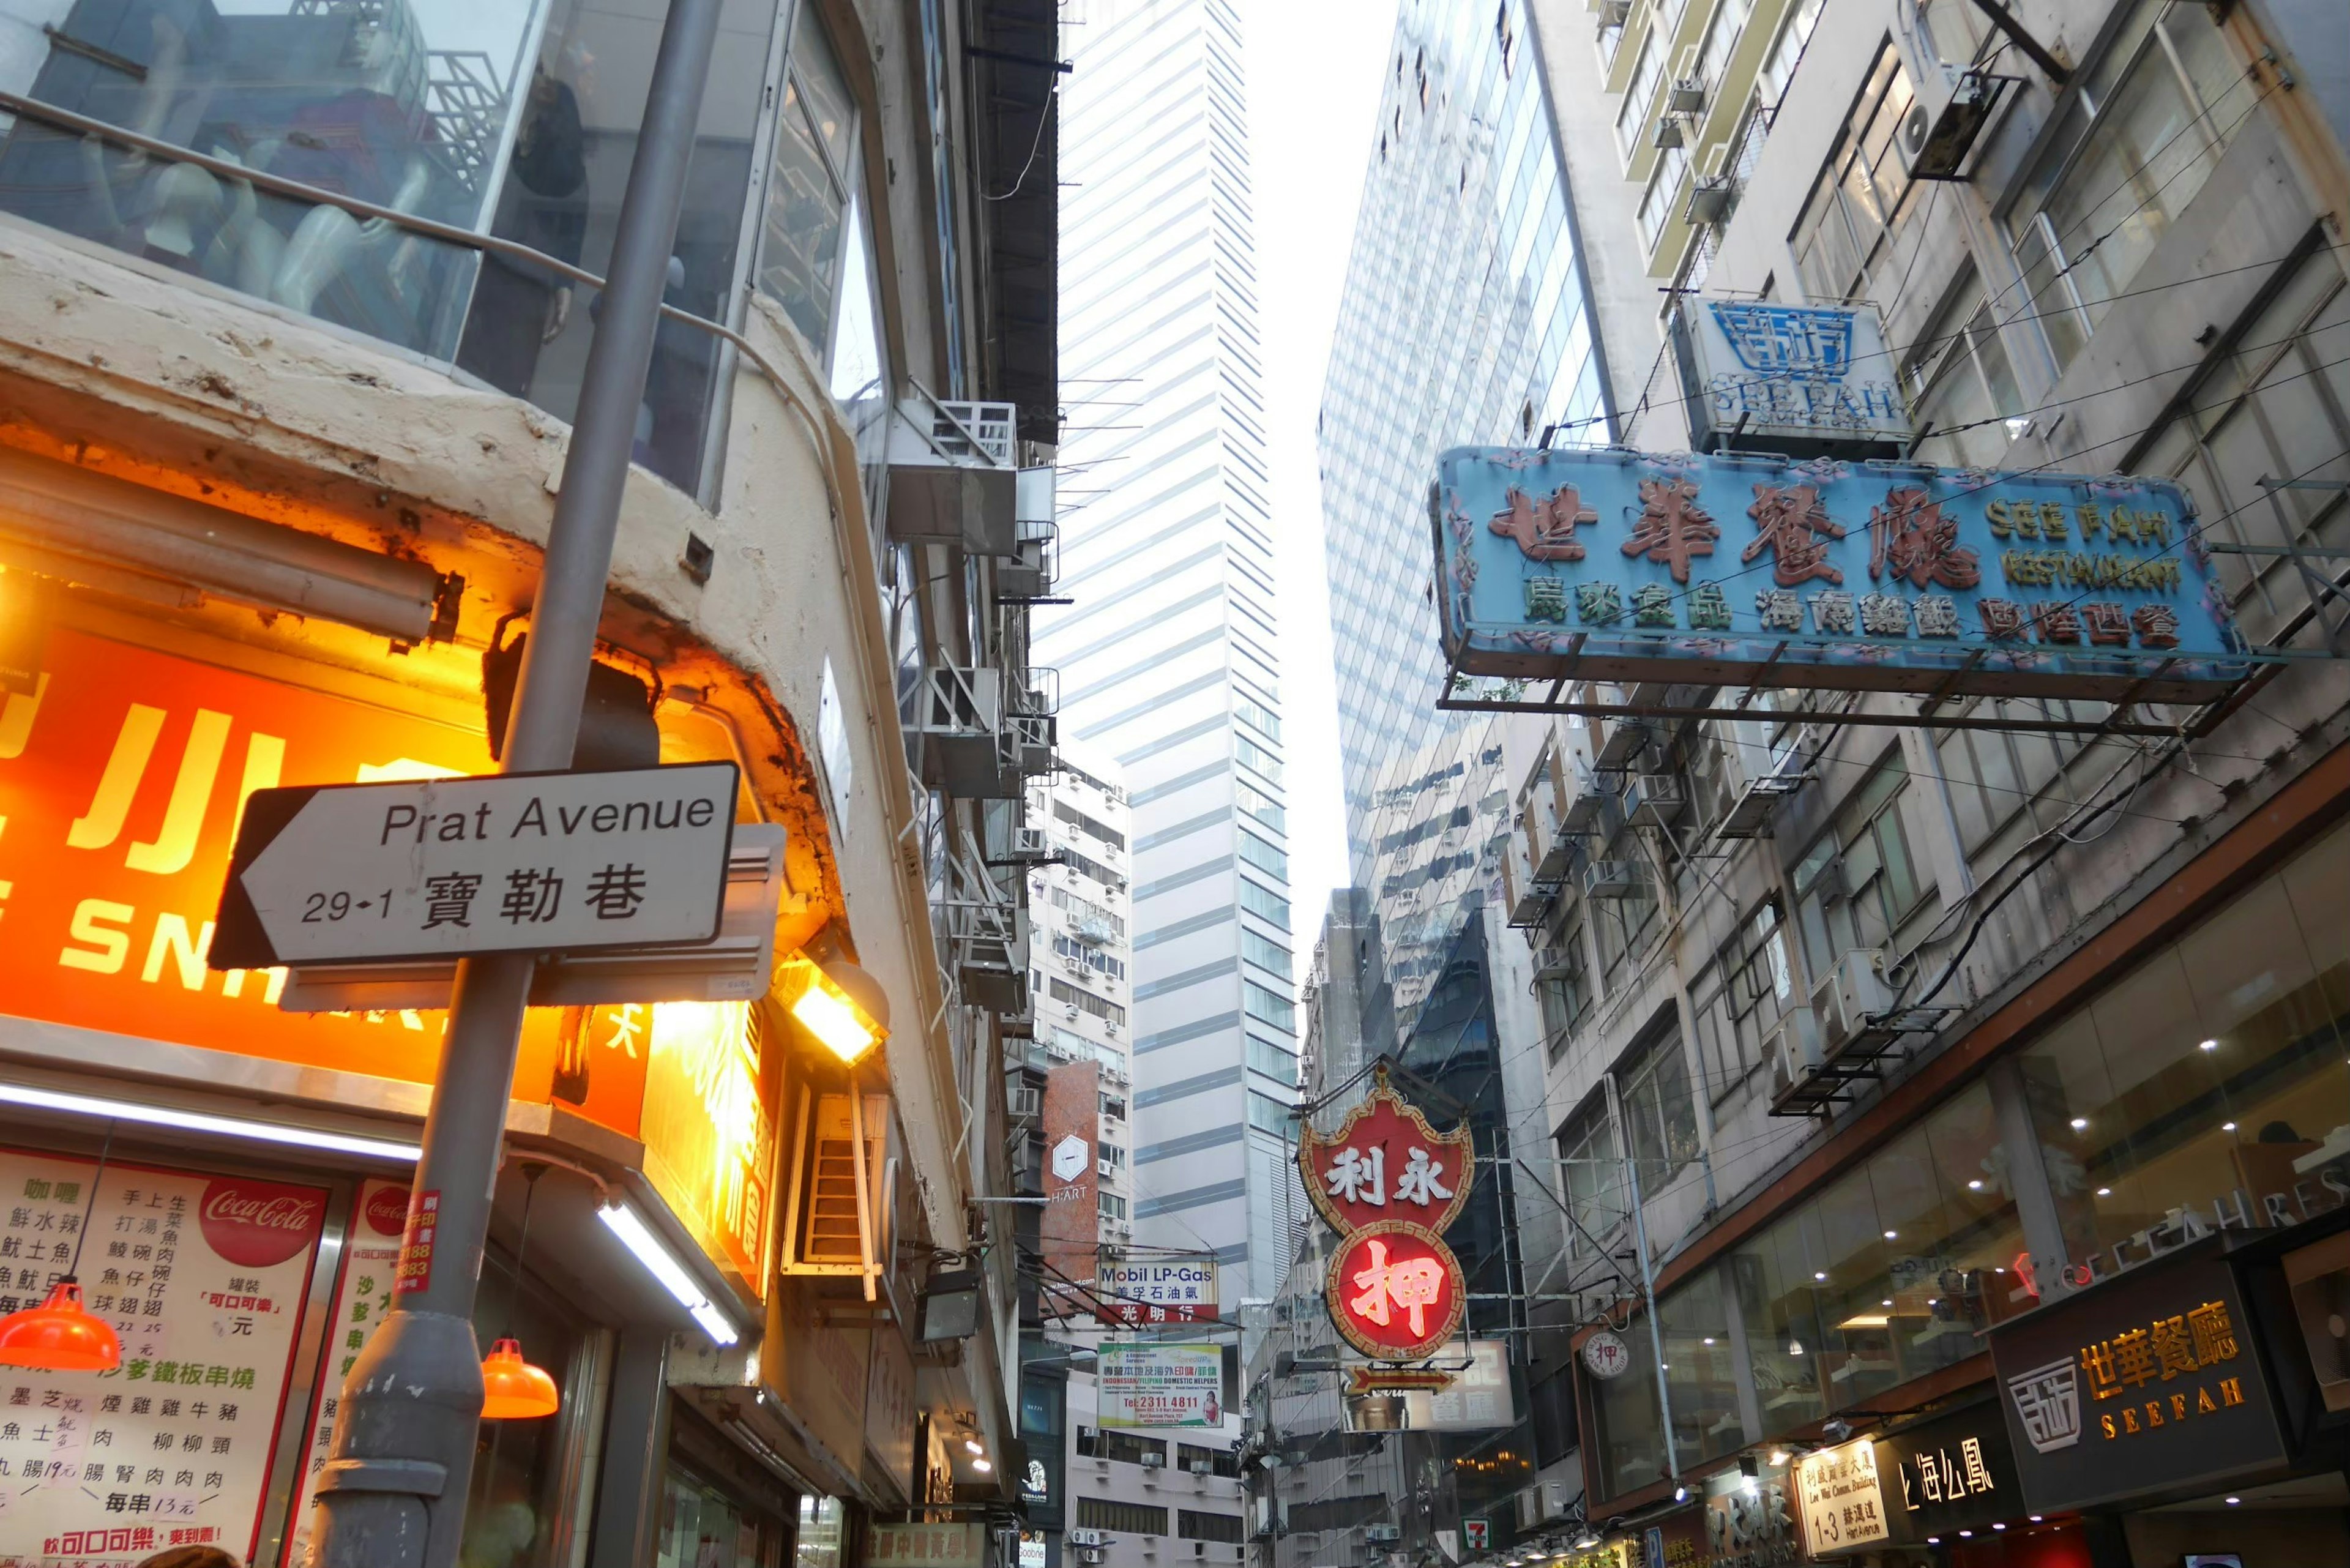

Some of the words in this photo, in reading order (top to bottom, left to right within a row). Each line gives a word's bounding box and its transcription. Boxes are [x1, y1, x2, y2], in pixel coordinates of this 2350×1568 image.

[1985, 498, 2070, 539] SEE
[2076, 502, 2173, 547] FAH
[380, 803, 491, 846] Prat
[510, 795, 715, 839] Avenue
[420, 864, 646, 930] 寶勒巷
[1102, 1267, 1147, 1282] Mobil
[1154, 1268, 1212, 1282] LP-Gas
[1349, 1239, 1445, 1338] 押
[232, 1316, 253, 1335] 元
[1121, 1305, 1195, 1321] 光明行
[143, 1323, 162, 1333] 25
[1595, 1342, 1617, 1367] 押
[1611, 1337, 1627, 1353] LEE
[2081, 1301, 2239, 1401] 世華餐廳
[1610, 1355, 1626, 1372] SHOP
[1124, 1398, 1138, 1407] Tel:
[1141, 1397, 1166, 1407] 2311
[1171, 1397, 1198, 1407] 4811
[2100, 1376, 2245, 1440] SEEFAH
[1810, 1491, 1819, 1504] Lee
[1851, 1475, 1878, 1495] Building
[105, 1491, 151, 1514] 每串
[1469, 1523, 1485, 1550] 7
[1815, 1511, 1840, 1546] 1-3
[1845, 1526, 1859, 1540] Hart
[1857, 1522, 1881, 1538] Avenue
